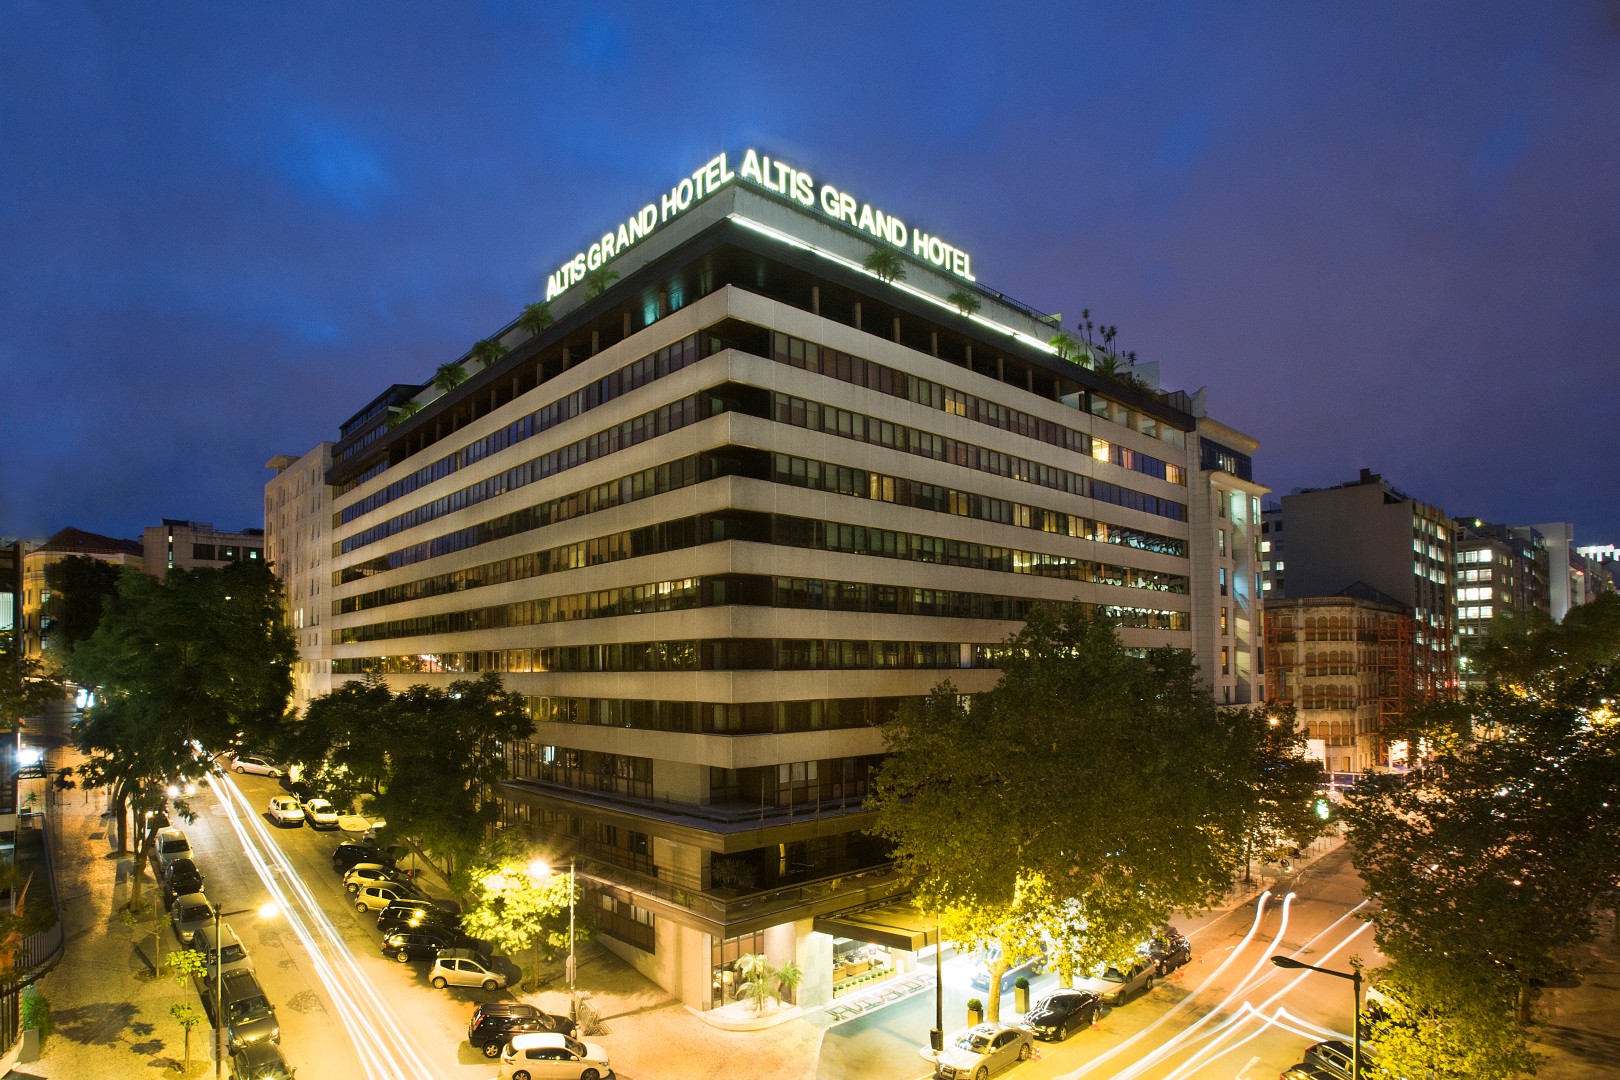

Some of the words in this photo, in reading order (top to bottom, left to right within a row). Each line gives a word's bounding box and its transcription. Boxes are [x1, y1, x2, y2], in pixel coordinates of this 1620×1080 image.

[546, 252, 586, 302] ALTIS
[588, 204, 657, 271] GRAND
[662, 152, 735, 223] HOTEL
[741, 149, 815, 206] ALTIS
[820, 185, 907, 247] GRAND
[913, 229, 976, 282] HOTEL
